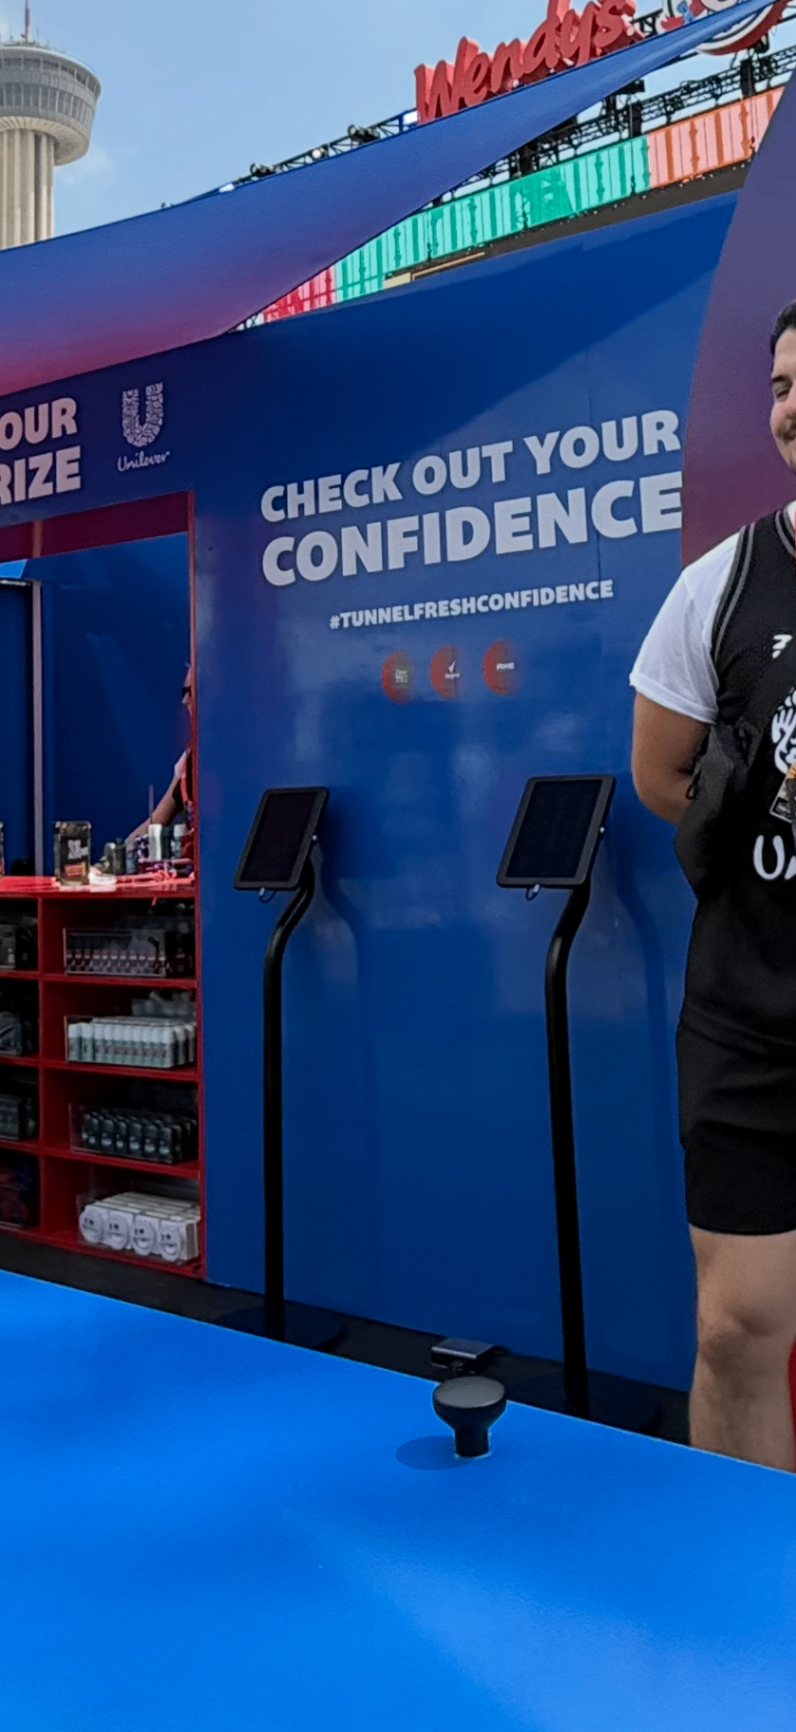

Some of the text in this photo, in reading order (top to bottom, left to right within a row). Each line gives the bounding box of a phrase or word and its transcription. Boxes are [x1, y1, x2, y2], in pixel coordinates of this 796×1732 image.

[117, 450, 170, 472] Unilever
[260, 410, 682, 523] CHECK OUT YOUR
[262, 470, 683, 587] CONFIDENCE
[329, 579, 614, 630] #TUNNELFRESHCONFIDENCE
